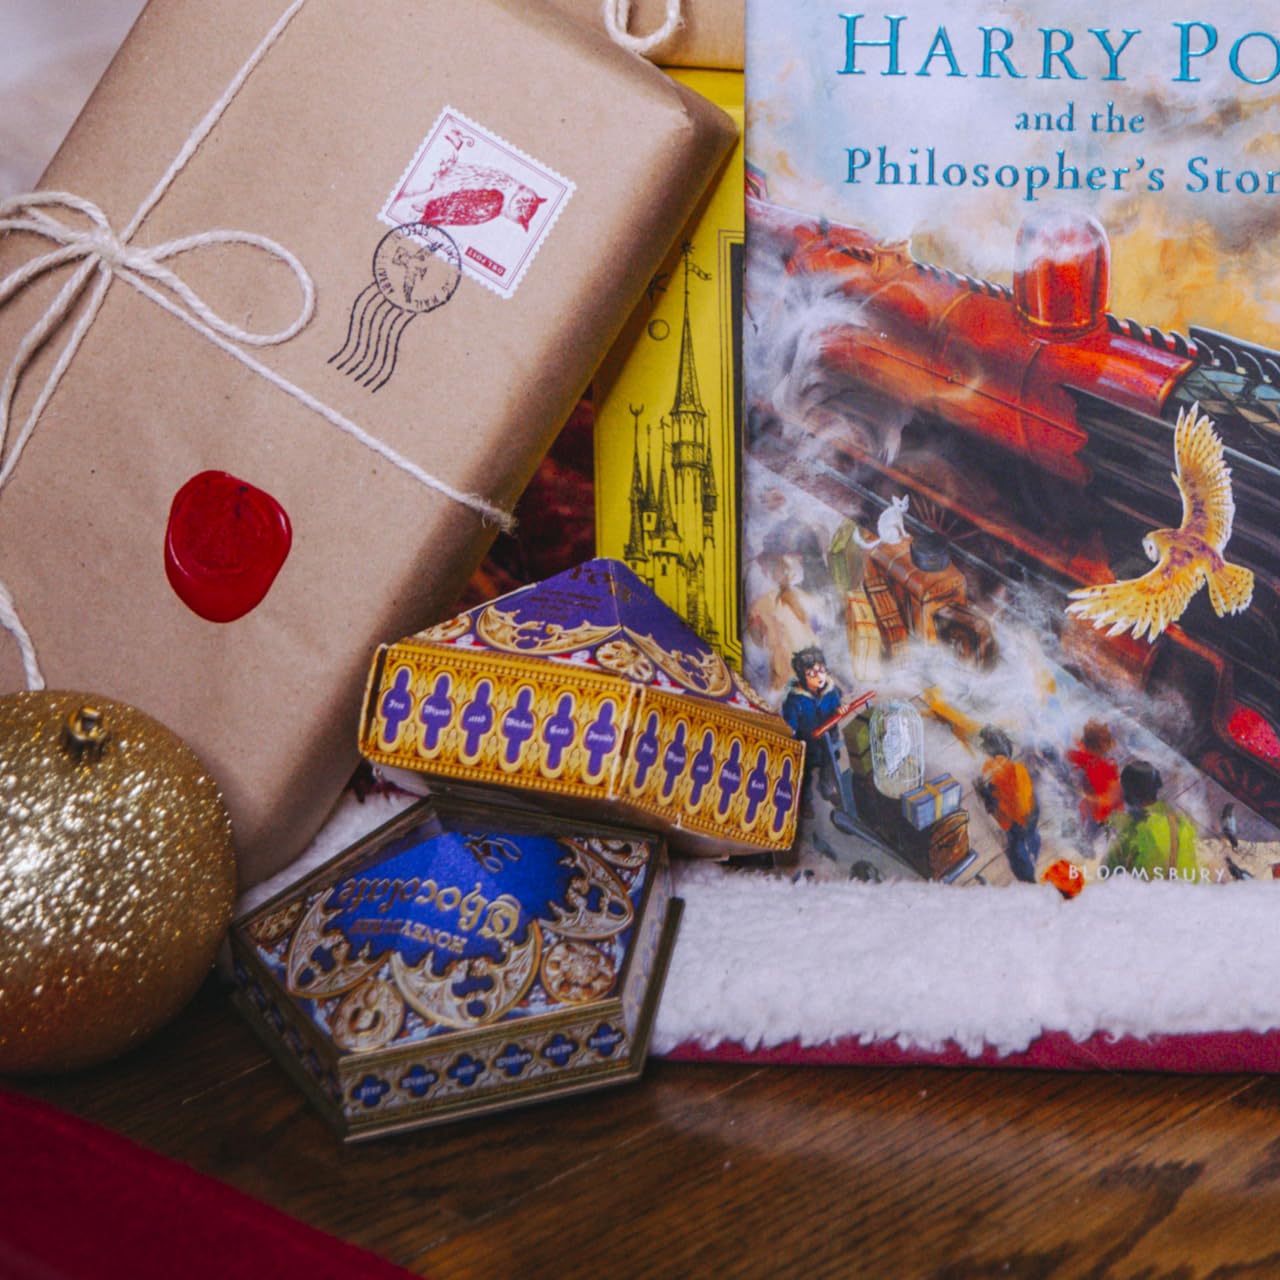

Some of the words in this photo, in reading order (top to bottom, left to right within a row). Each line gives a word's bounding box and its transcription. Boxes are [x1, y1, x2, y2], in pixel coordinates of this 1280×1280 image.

[838, 13, 1142, 82] HARRY
[1015, 101, 1076, 134] and
[1090, 103, 1146, 134] the
[845, 146, 1167, 201] Philosopher's
[1068, 863, 1226, 883] BLOOMSBURY
[338, 876, 521, 940] Chocolate
